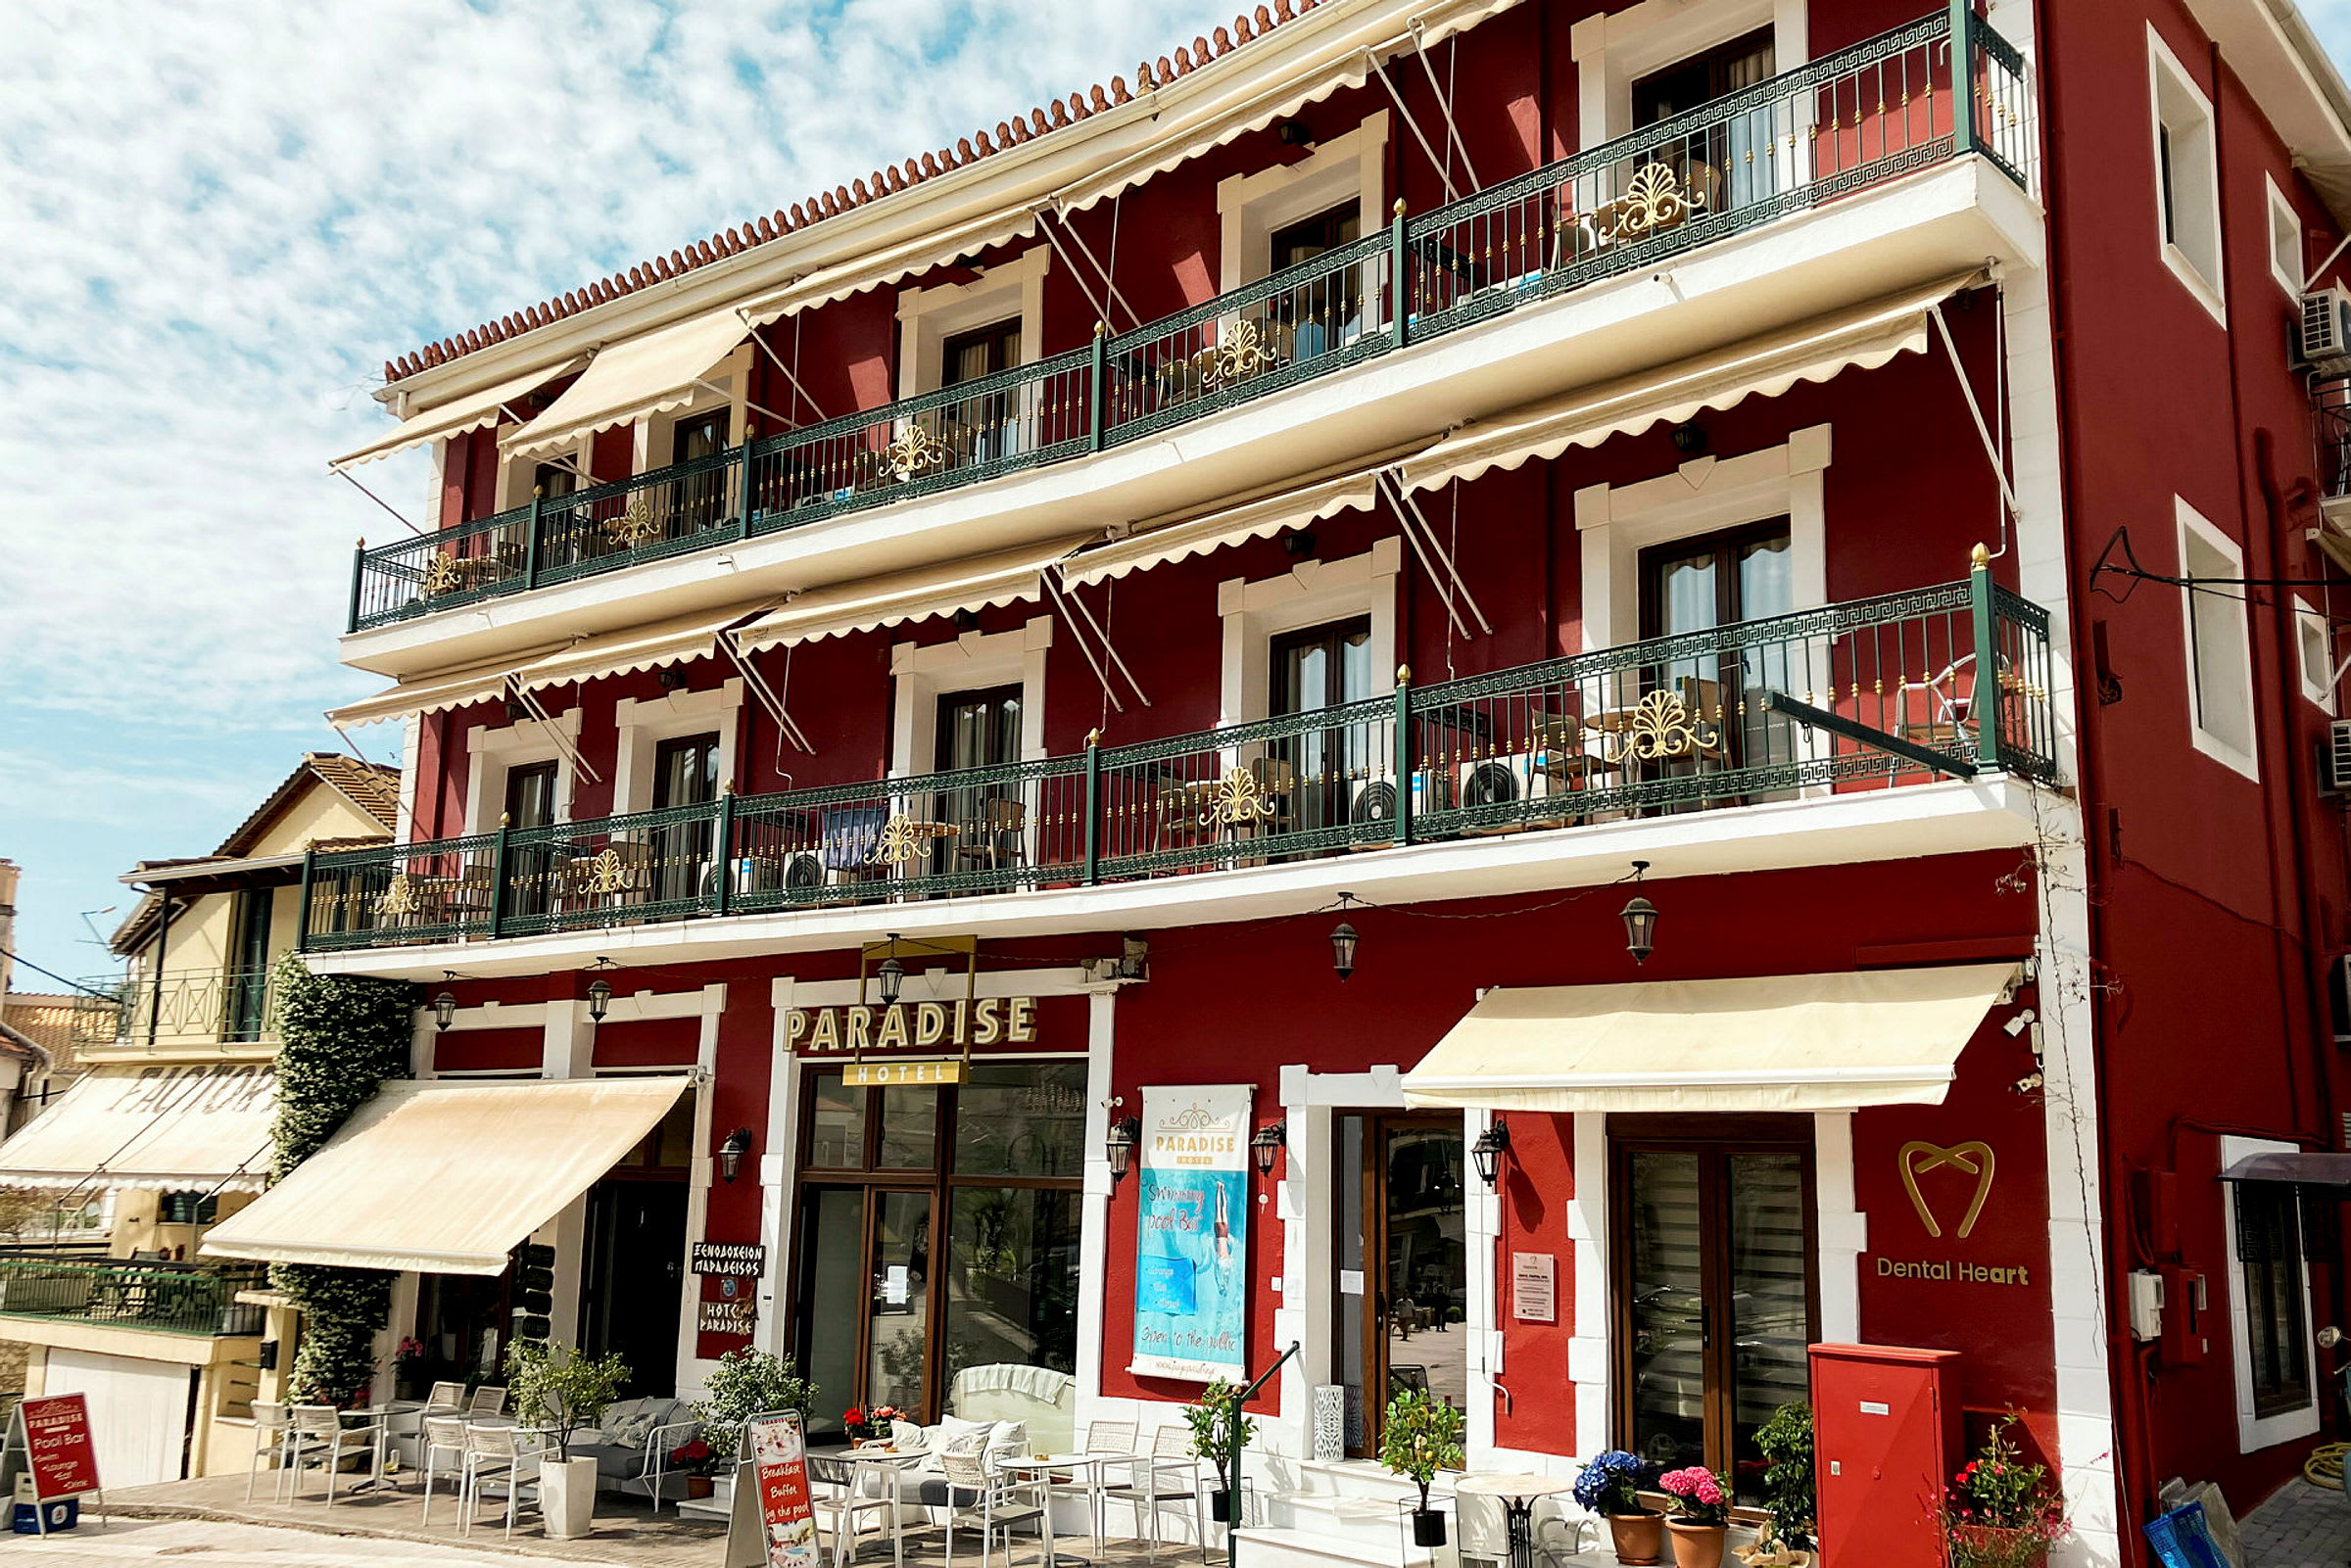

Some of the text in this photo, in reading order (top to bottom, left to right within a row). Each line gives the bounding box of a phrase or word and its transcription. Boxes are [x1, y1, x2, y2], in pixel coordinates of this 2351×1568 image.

[784, 997, 1036, 1051] PARADISE
[857, 1065, 943, 1082] HOTEL
[1156, 1136, 1234, 1153] PARADISE
[1148, 1183, 1206, 1213] Swimming
[1147, 1208, 1204, 1238] pool Bar
[1878, 1258, 2029, 1285] Dental Heart
[707, 1304, 747, 1318] HOTE
[698, 1318, 752, 1332] PARADISE
[1173, 1332, 1183, 1346] to
[1187, 1330, 1202, 1348] the
[1207, 1331, 1235, 1354] public
[29, 1412, 83, 1429] PARADISE
[33, 1433, 85, 1449] Pool Bar
[761, 1462, 801, 1480] Breakfast
[770, 1483, 797, 1498] Buffet
[765, 1500, 808, 1523] by the pool
